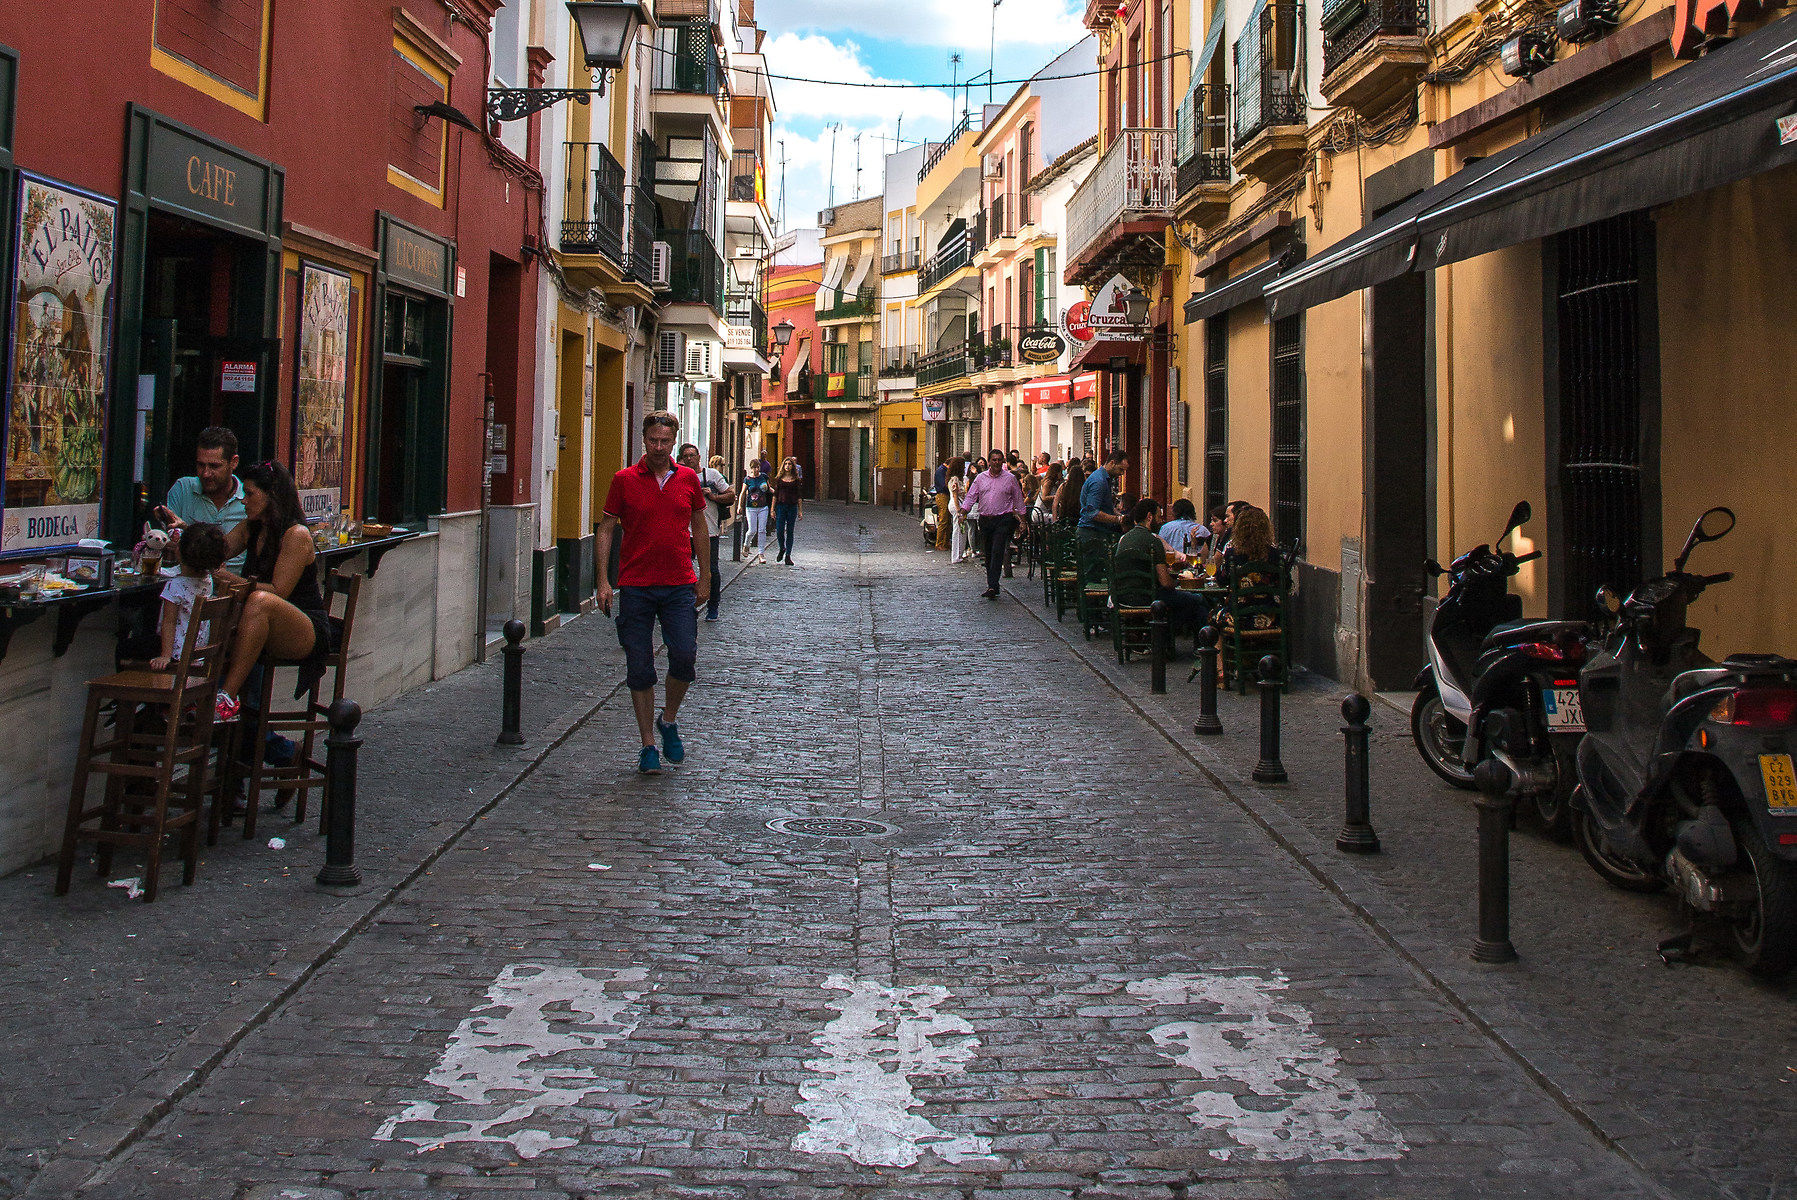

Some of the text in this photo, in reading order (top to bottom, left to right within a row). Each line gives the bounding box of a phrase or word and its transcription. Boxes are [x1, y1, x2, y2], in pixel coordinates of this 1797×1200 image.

[187, 155, 236, 207] CAFE
[31, 207, 104, 286] EL PATIO
[396, 238, 439, 279] LICORES
[322, 282, 344, 335] PATIO
[1090, 314, 1150, 326] Cruzcao
[1021, 336, 1059, 350] Coca-Cola
[27, 514, 79, 539] BODEGA
